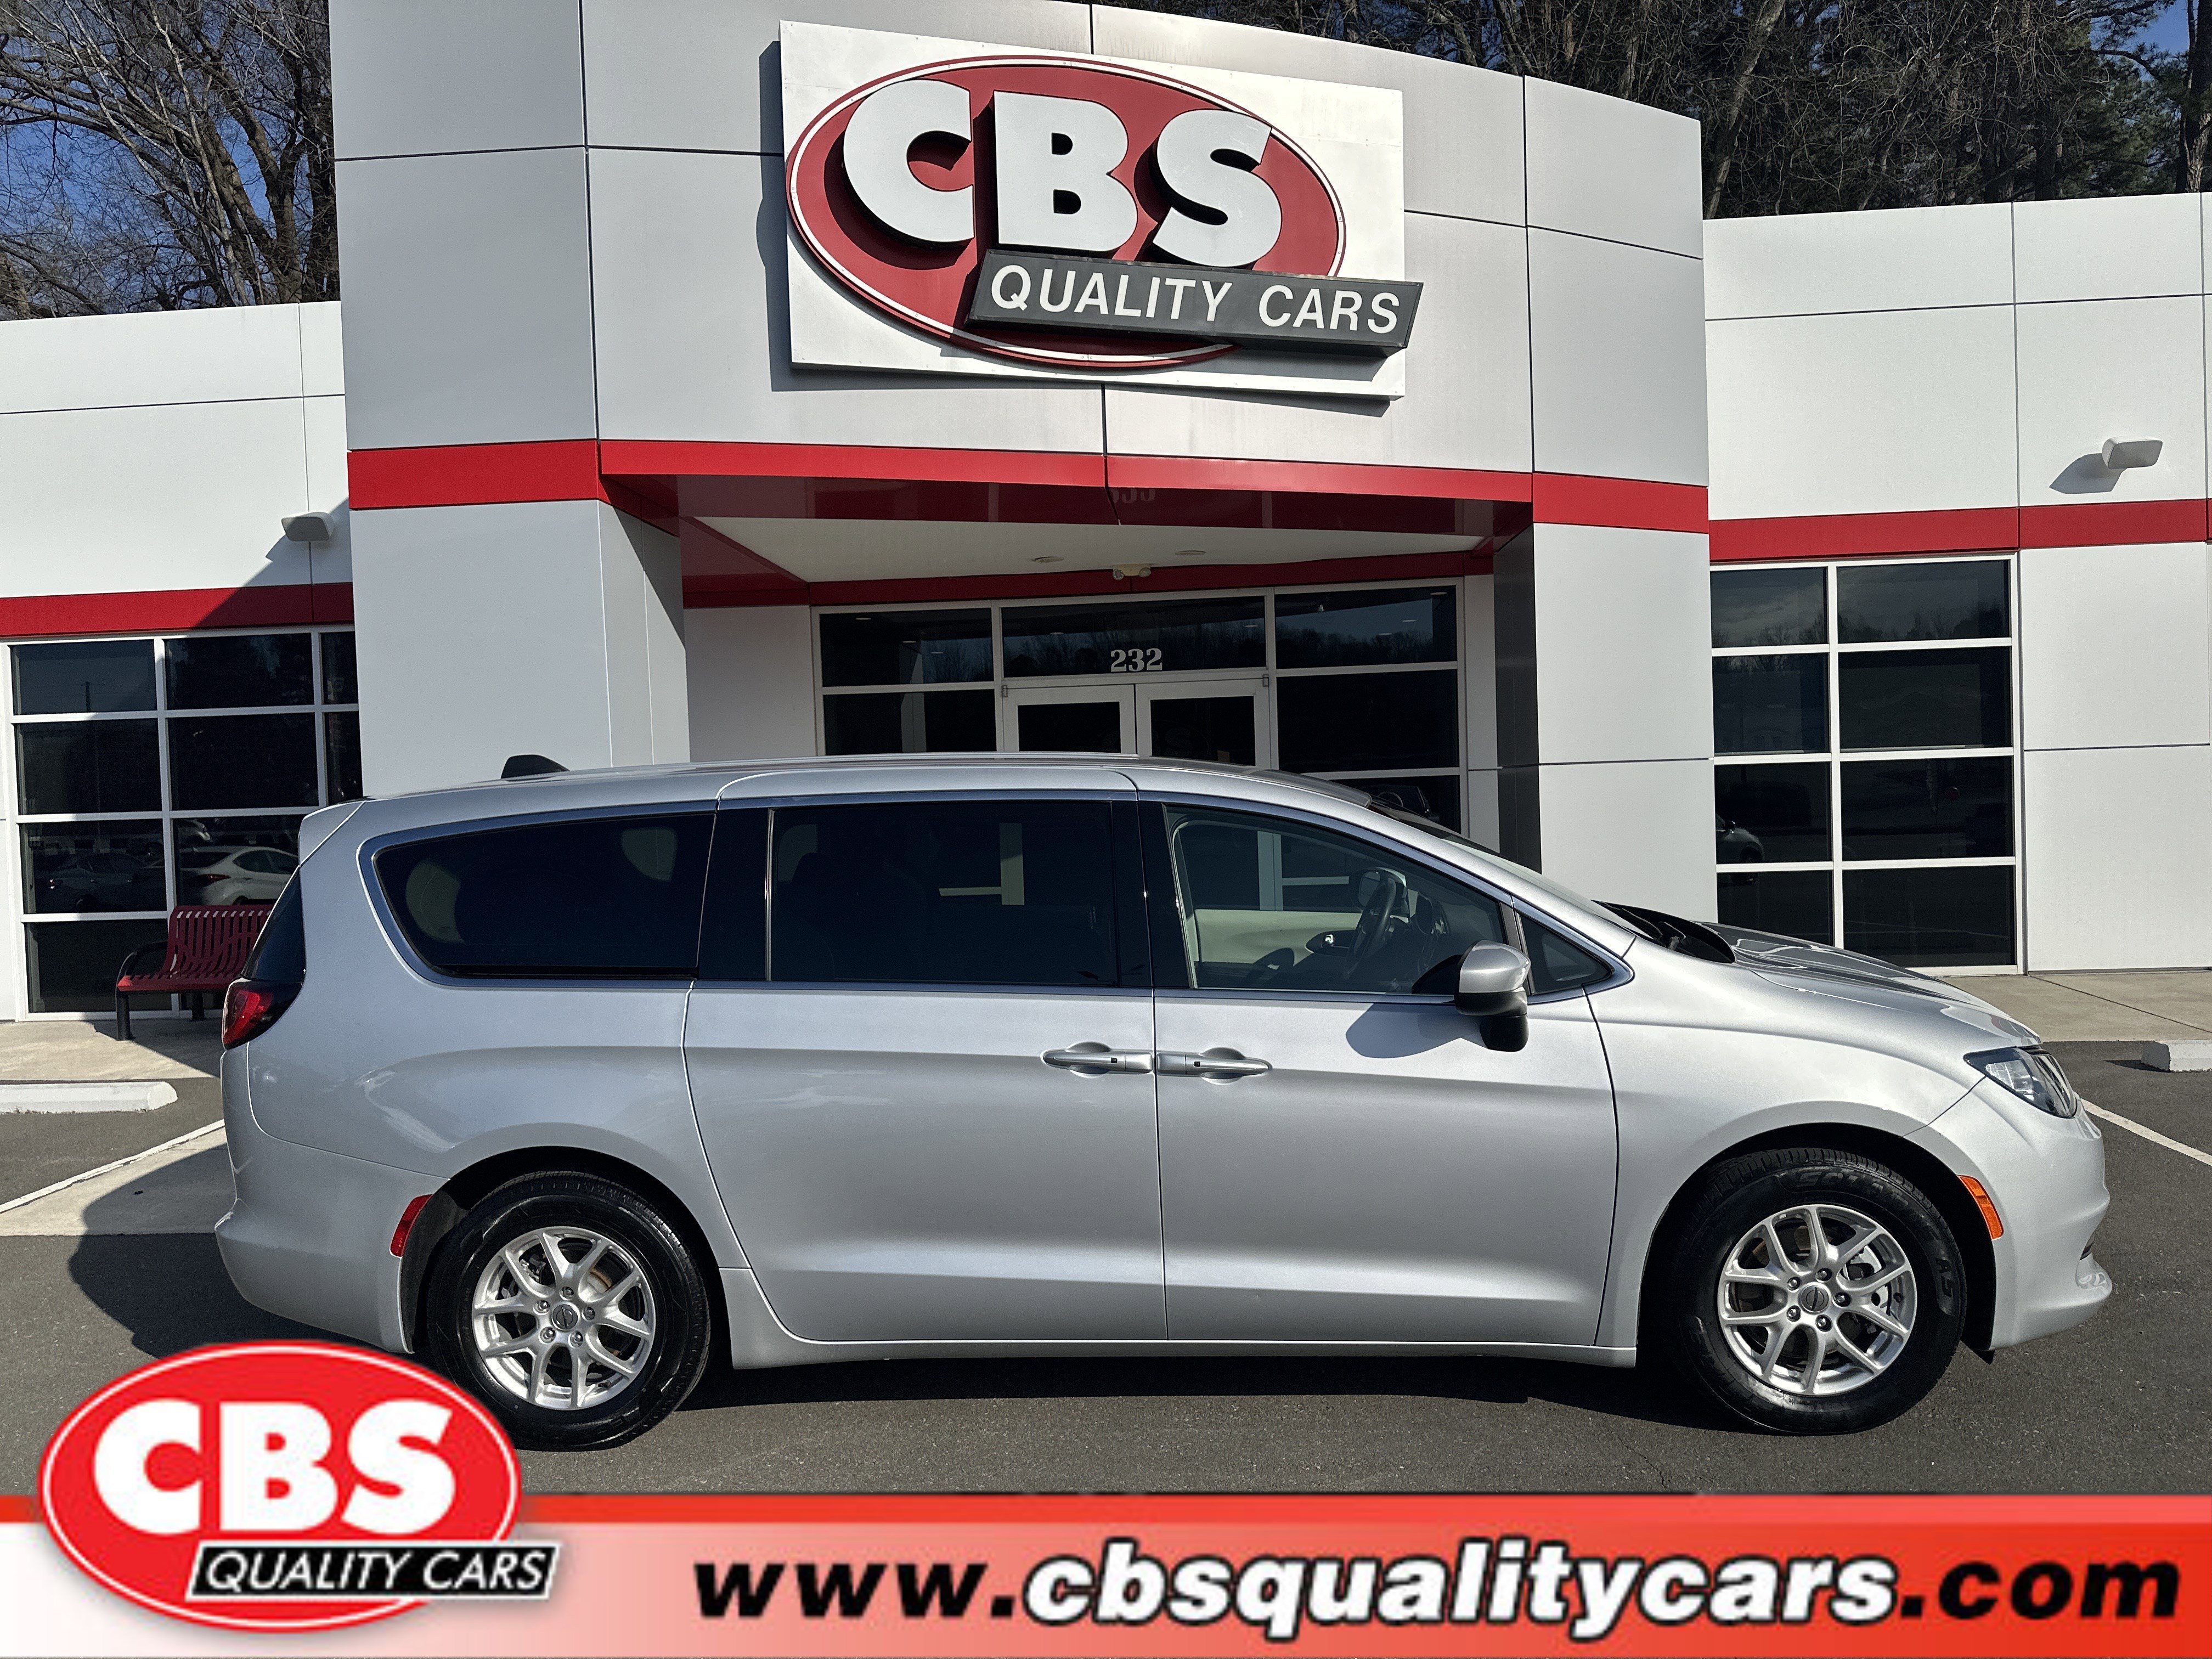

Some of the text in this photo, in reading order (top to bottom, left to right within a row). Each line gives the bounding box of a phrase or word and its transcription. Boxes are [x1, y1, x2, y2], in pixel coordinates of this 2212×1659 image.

[843, 78, 1282, 269] CBS
[990, 264, 1399, 335] QUALITY CARS
[1110, 647, 1163, 672] 232
